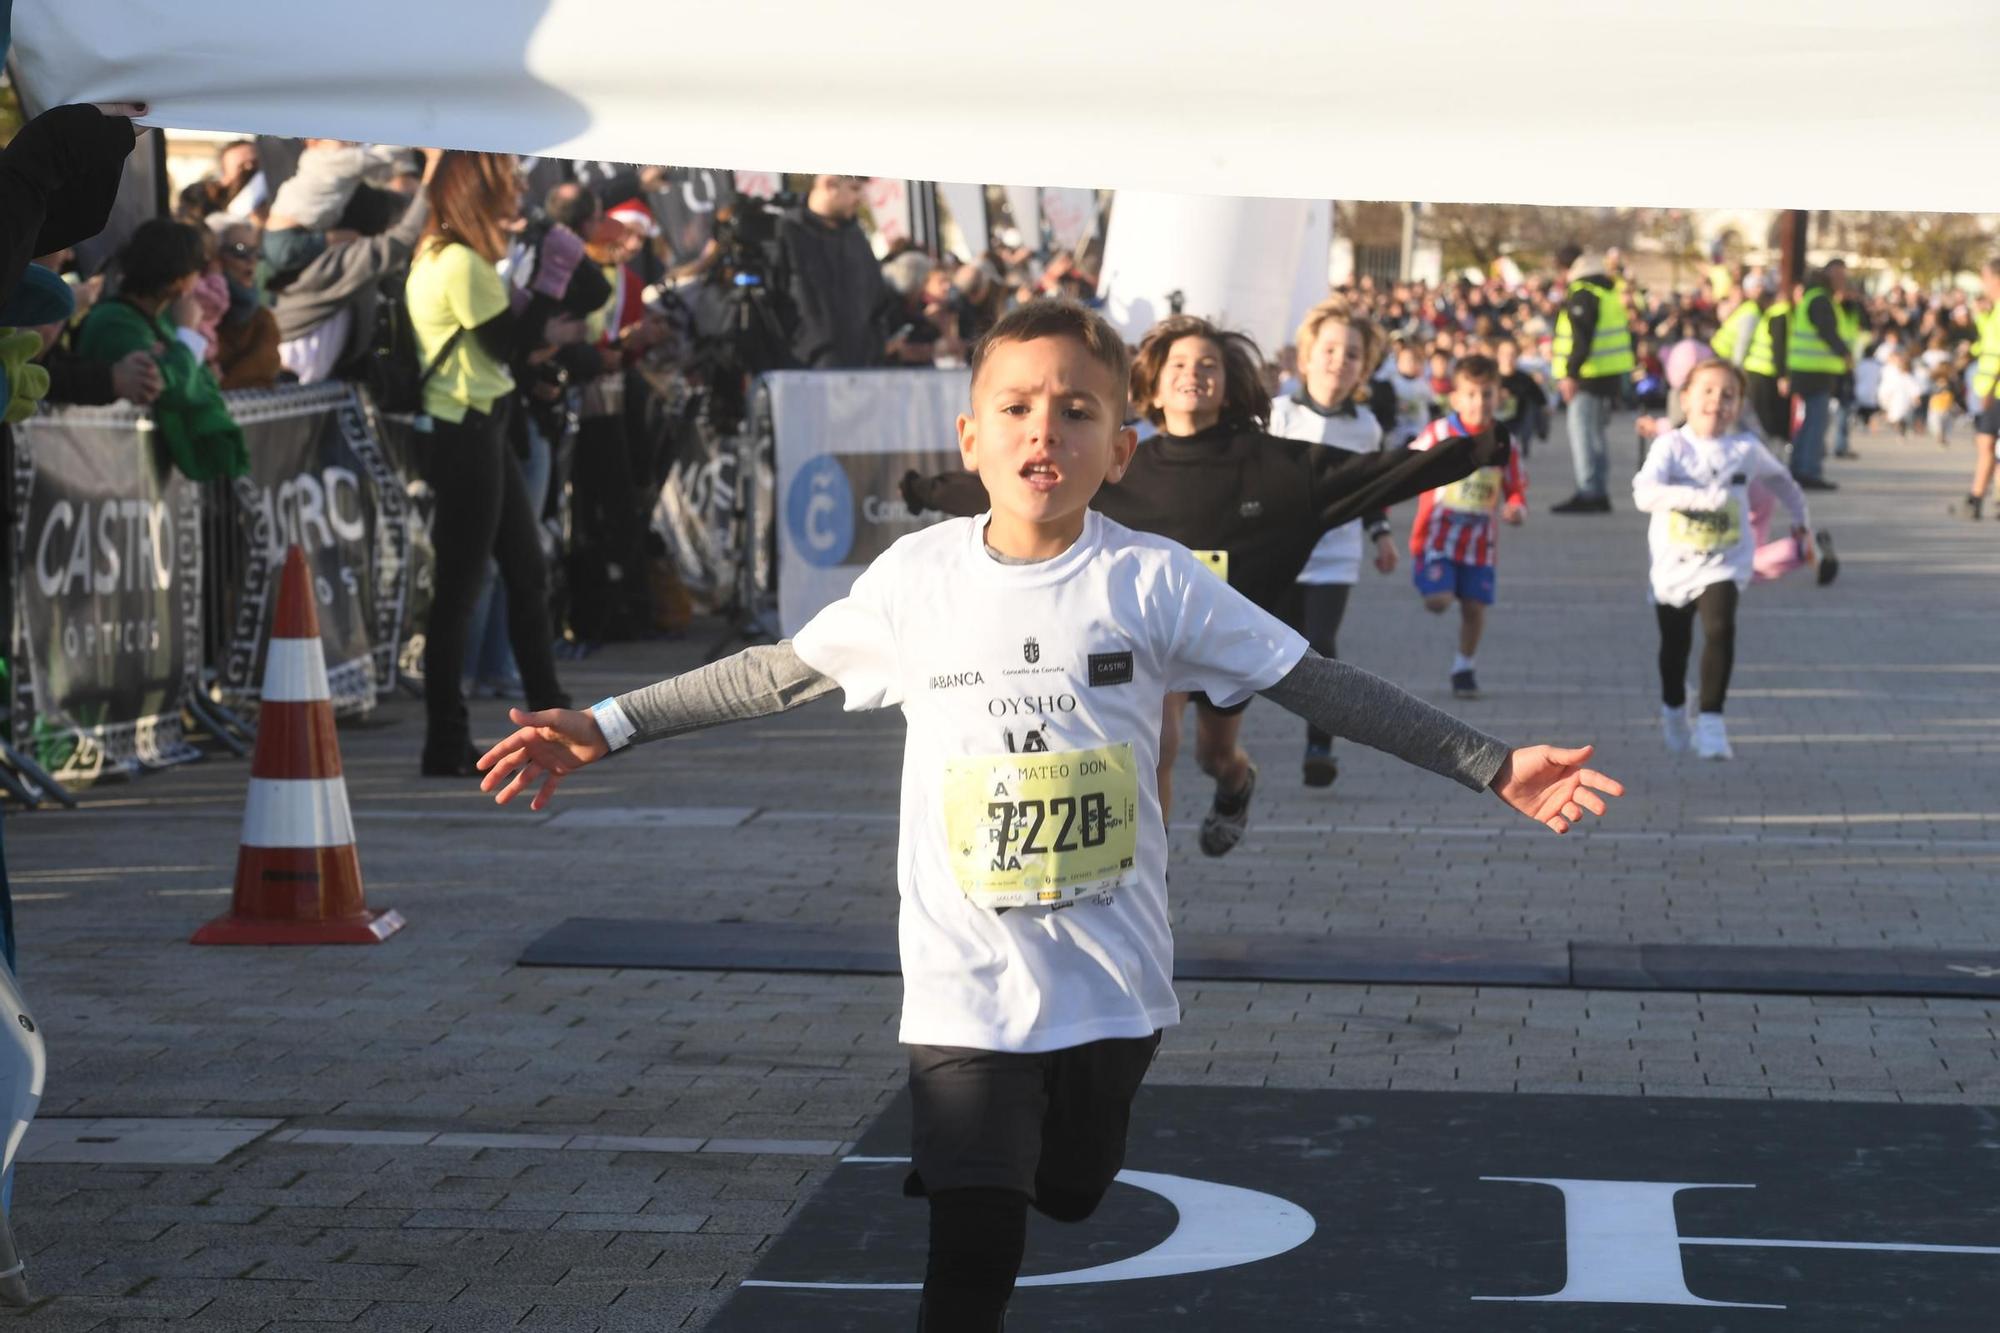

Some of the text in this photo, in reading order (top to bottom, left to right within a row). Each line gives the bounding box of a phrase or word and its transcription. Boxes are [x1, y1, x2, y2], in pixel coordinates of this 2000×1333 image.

[36, 500, 175, 597] CASTRO
[1097, 661, 1127, 673] CASTRO
[931, 671, 985, 689] ABANCA
[988, 693, 1076, 717] OYSHO
[1018, 759, 1107, 781] MATEO DON
[987, 791, 1105, 857] 7220
